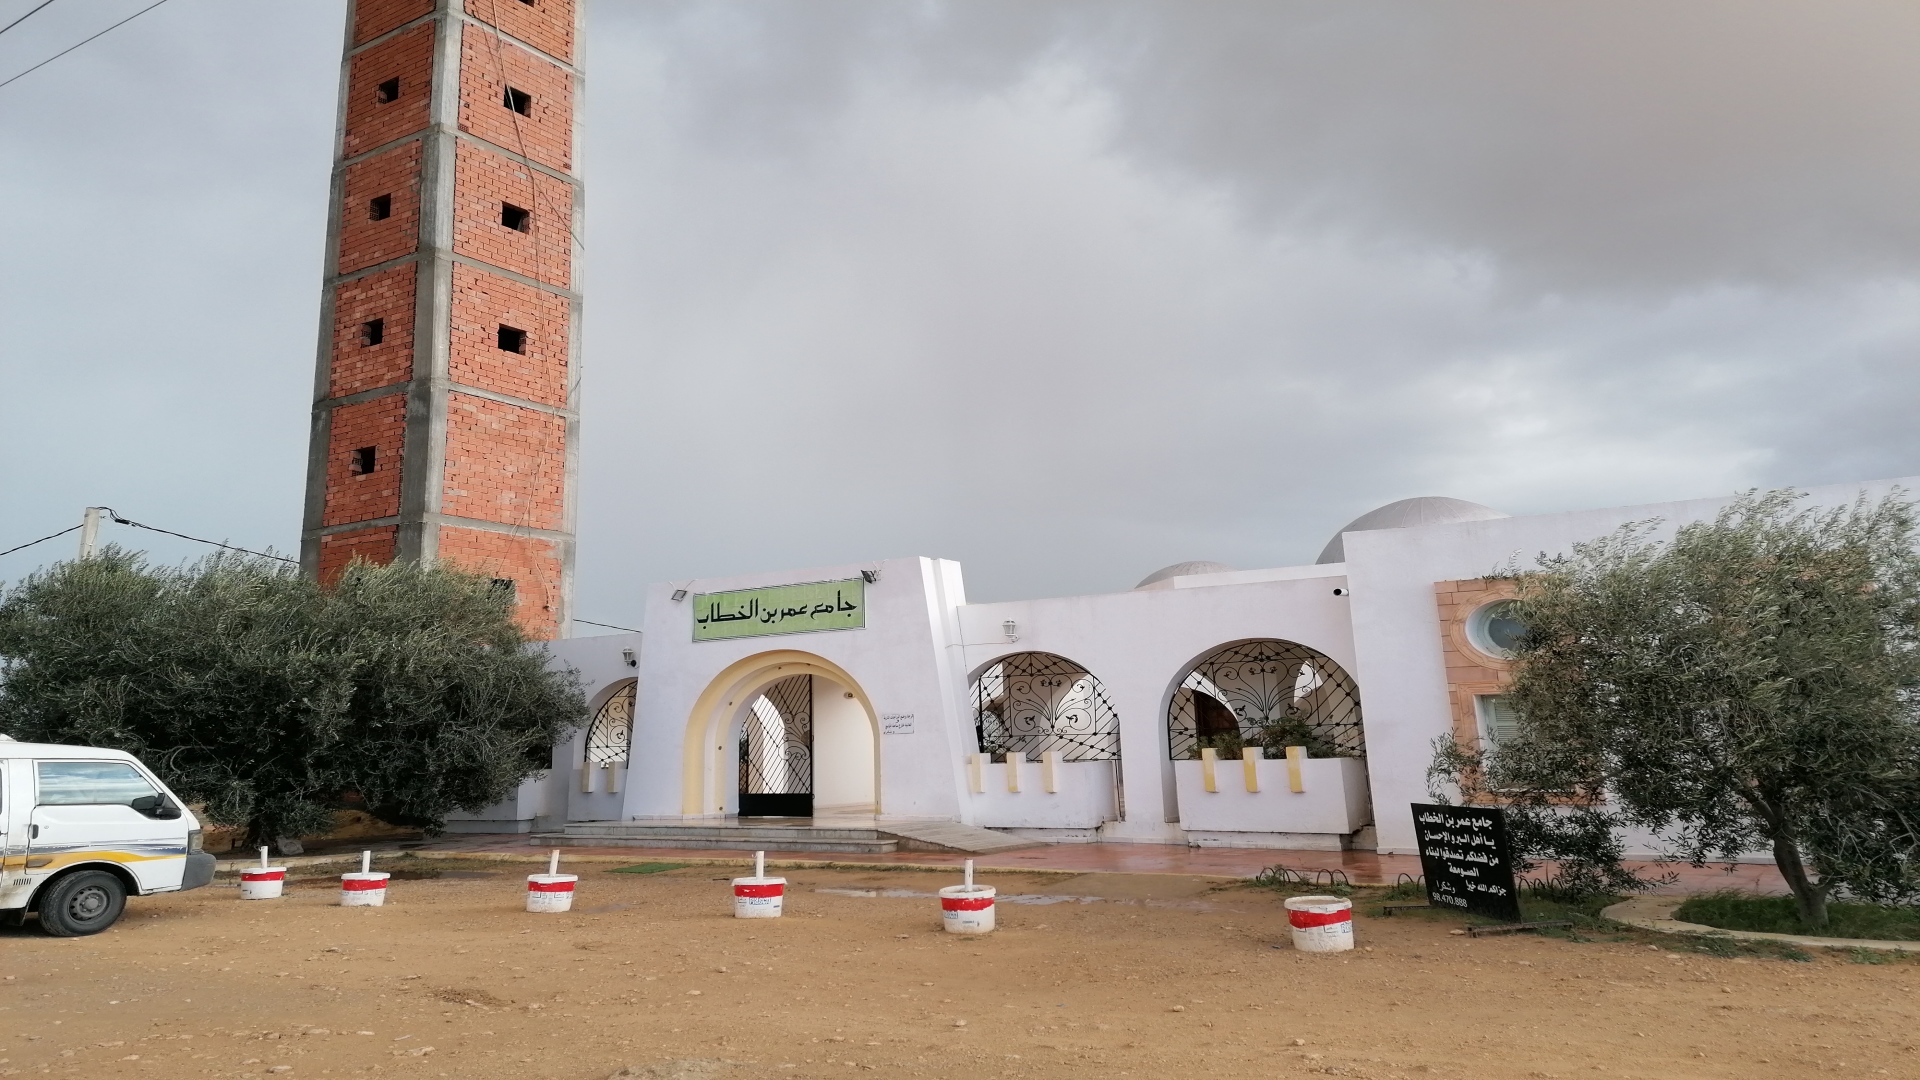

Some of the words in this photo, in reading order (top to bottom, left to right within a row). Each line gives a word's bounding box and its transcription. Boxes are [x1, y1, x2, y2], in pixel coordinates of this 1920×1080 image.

[811, 590, 857, 620] جامع
[697, 598, 759, 629] الخطاب
[760, 608, 778, 624] بن
[779, 604, 807, 622] عمر
[1419, 812, 1444, 825] الخطاب
[1445, 814, 1455, 828] بن
[1455, 817, 1471, 828] عمر
[1471, 816, 1493, 831] جامع
[1456, 834, 1471, 845] البر
[1471, 833, 1484, 846] أهل
[1484, 835, 1496, 849] يا
[1425, 846, 1440, 859] لبناء
[1440, 846, 1464, 860] تصدقوا
[1465, 851, 1488, 863] فضلكم
[1489, 854, 1499, 866] من
[1447, 862, 1480, 877] الصومعة
[1477, 883, 1488, 892] الله
[1488, 884, 1507, 896] جزاكم
[1432, 891, 1468, 908] 98.470.888
